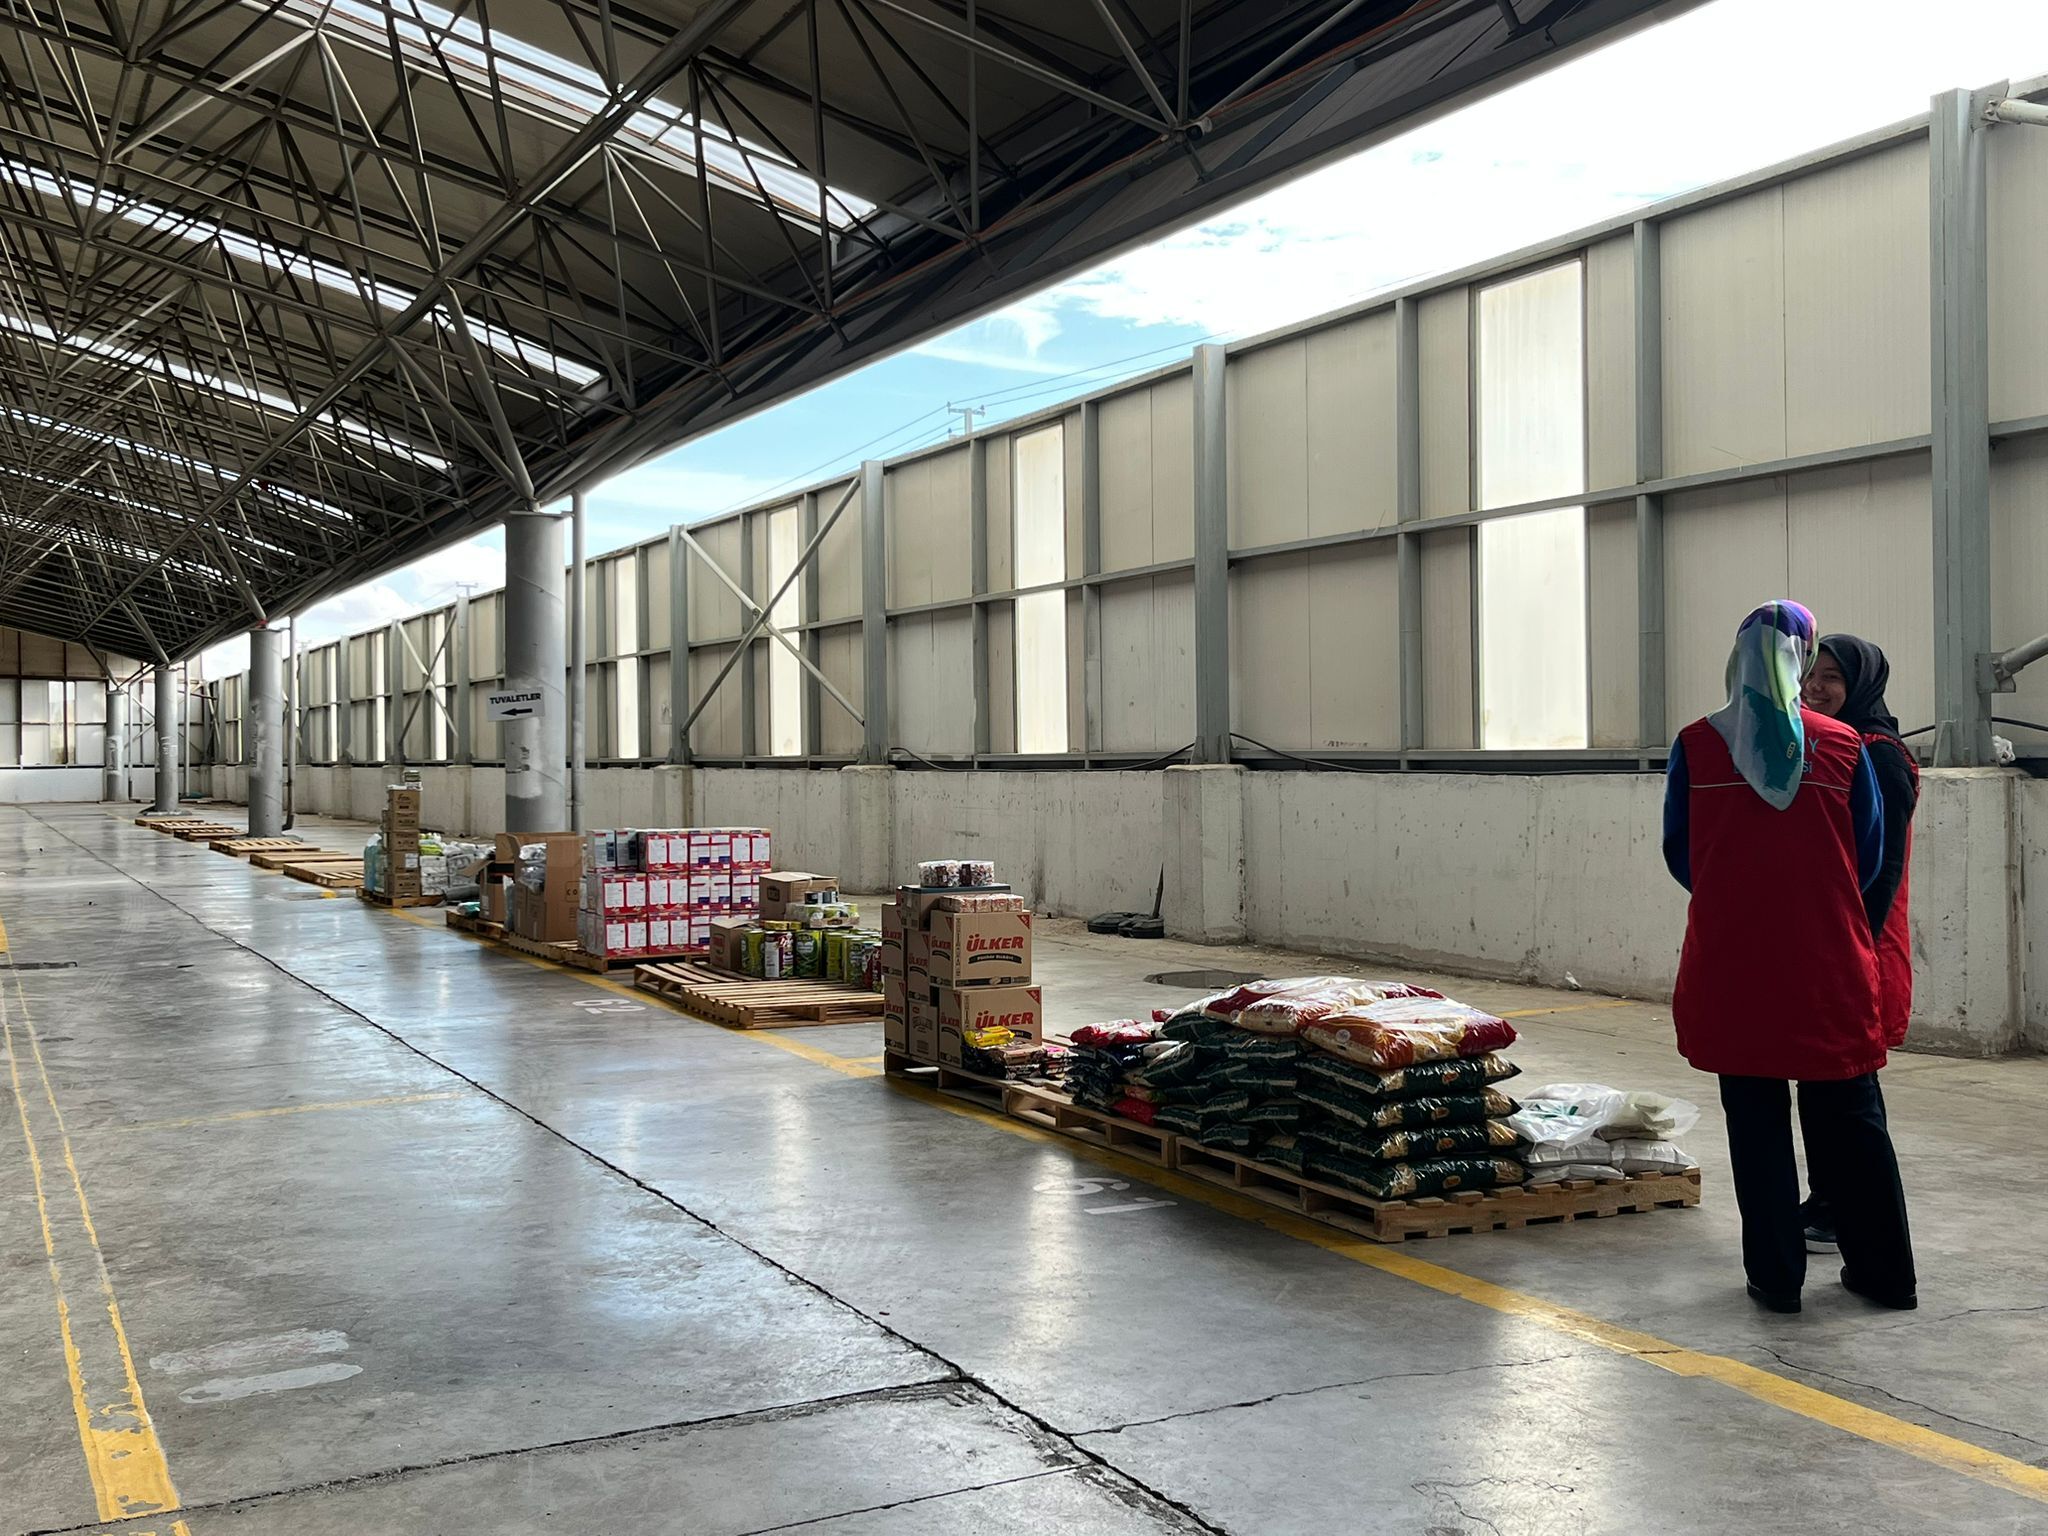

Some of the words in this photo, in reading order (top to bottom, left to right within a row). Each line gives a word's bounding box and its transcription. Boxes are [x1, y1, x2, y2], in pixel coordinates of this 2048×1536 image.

[489, 693, 541, 704] TUVALETLER
[966, 934, 1024, 952] ÜLKER
[975, 1010, 1034, 1029] ÜLKER
